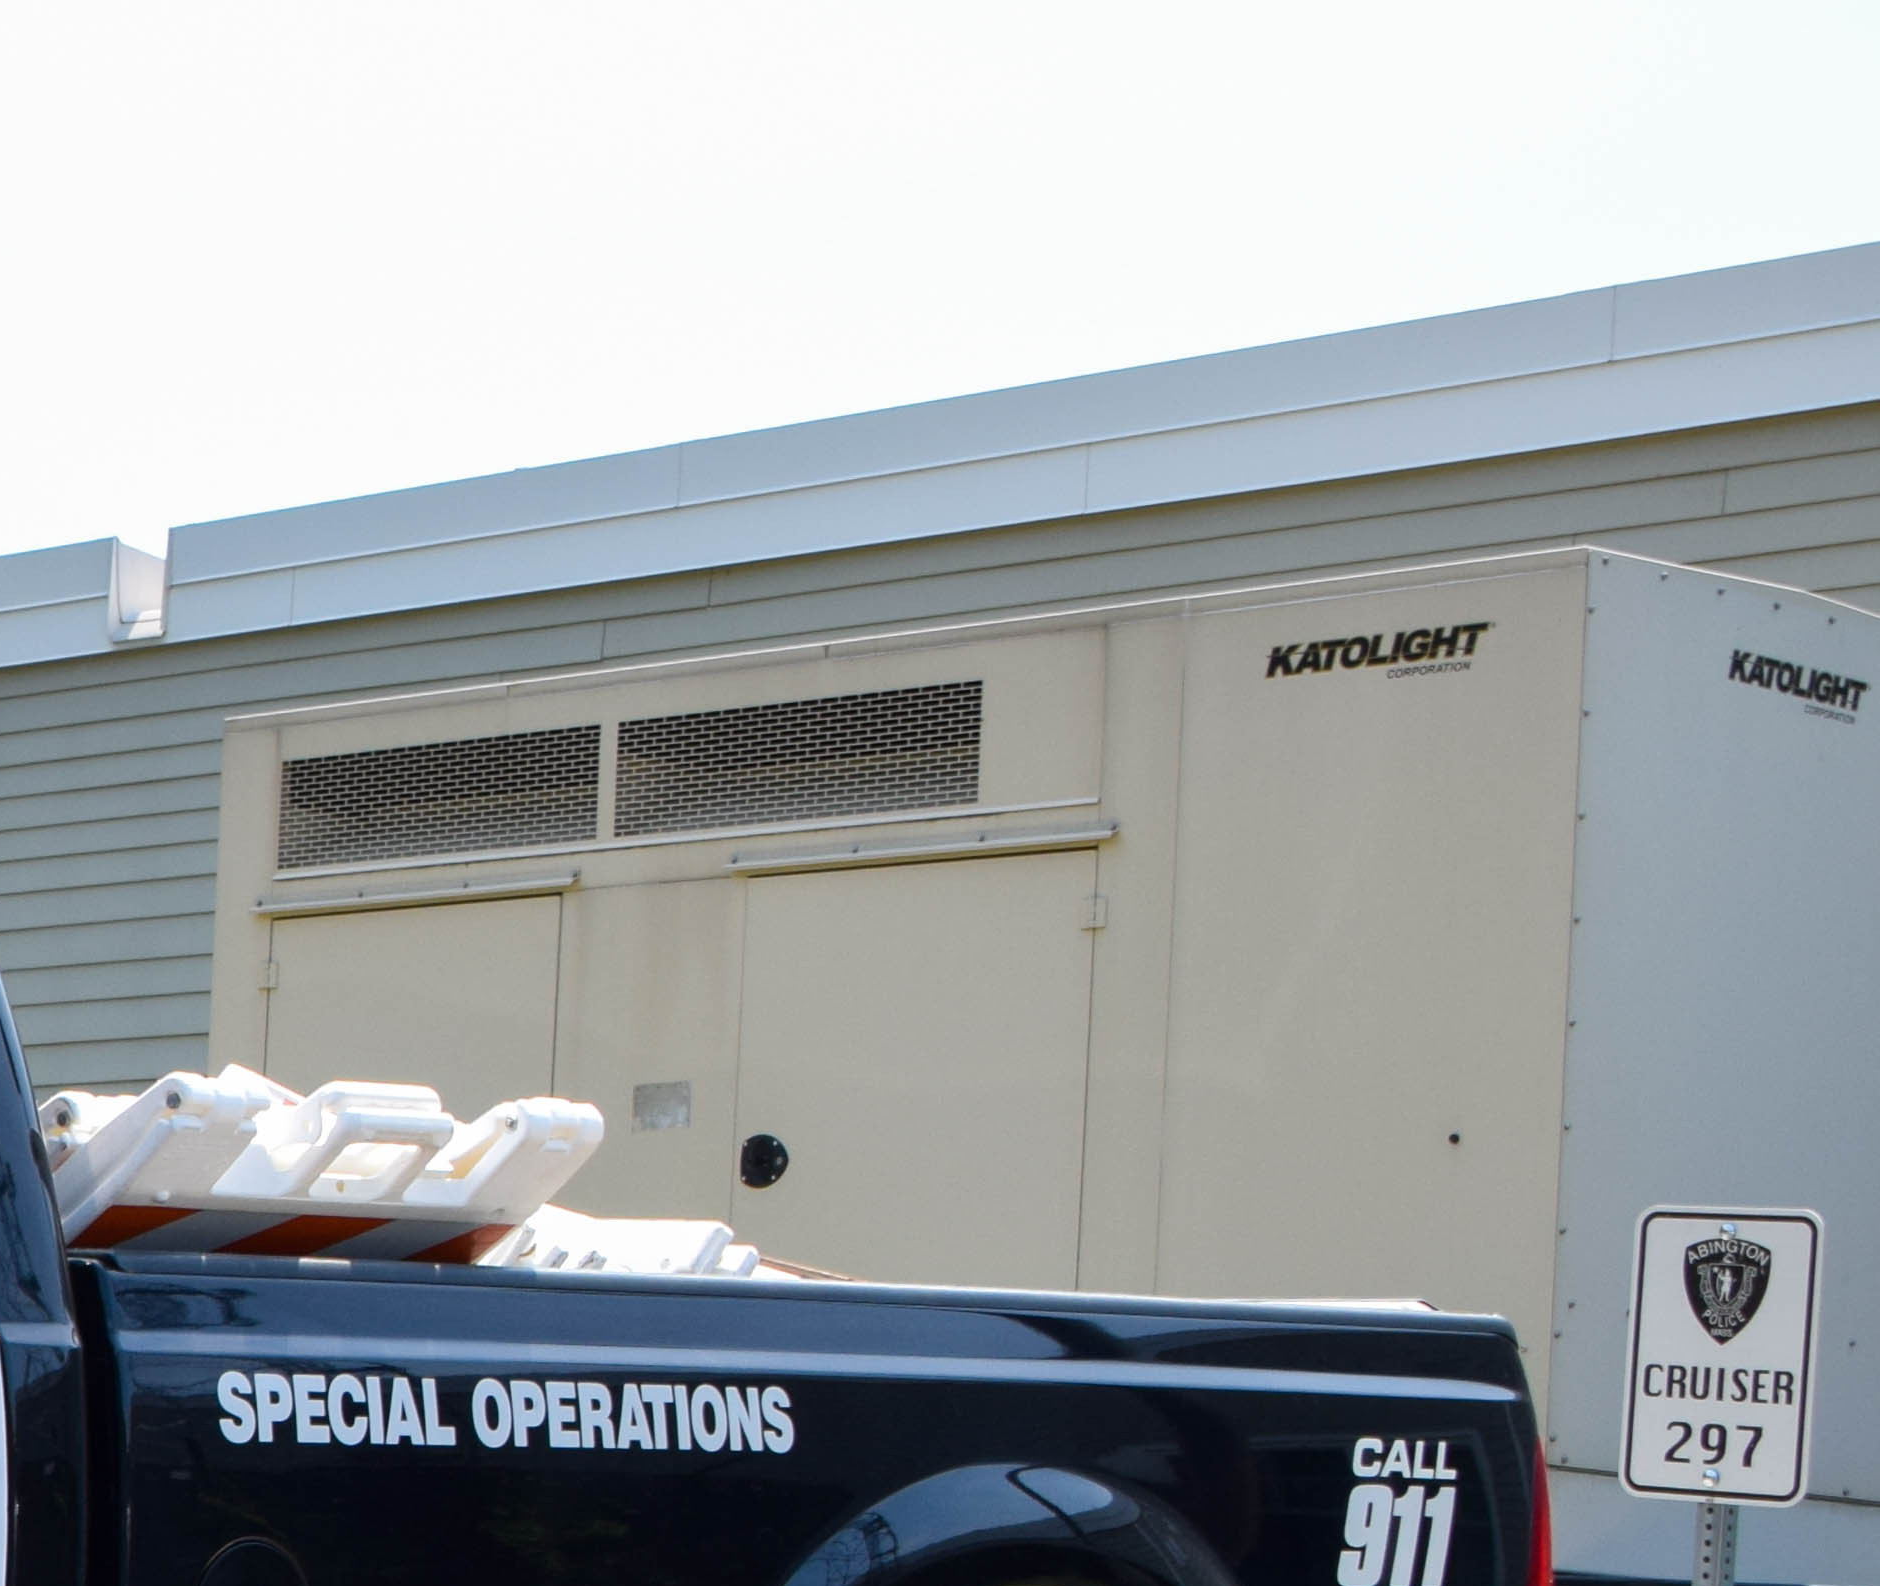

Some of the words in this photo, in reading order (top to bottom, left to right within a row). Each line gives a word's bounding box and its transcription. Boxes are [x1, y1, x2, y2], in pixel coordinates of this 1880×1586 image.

[1266, 621, 1491, 679] KATOLIGHT
[1387, 661, 1471, 679] CORPORATION
[1728, 649, 1868, 711] KATOLIGHT
[1687, 1240, 1770, 1264] ABINGTON
[1702, 1308, 1745, 1328] POLICE
[1643, 1363, 1794, 1405] CRUISER
[217, 1370, 457, 1446] SPECIAL
[472, 1377, 795, 1454] OPERATIONS
[1352, 1437, 1458, 1480] CALL
[1664, 1421, 1763, 1468] 297
